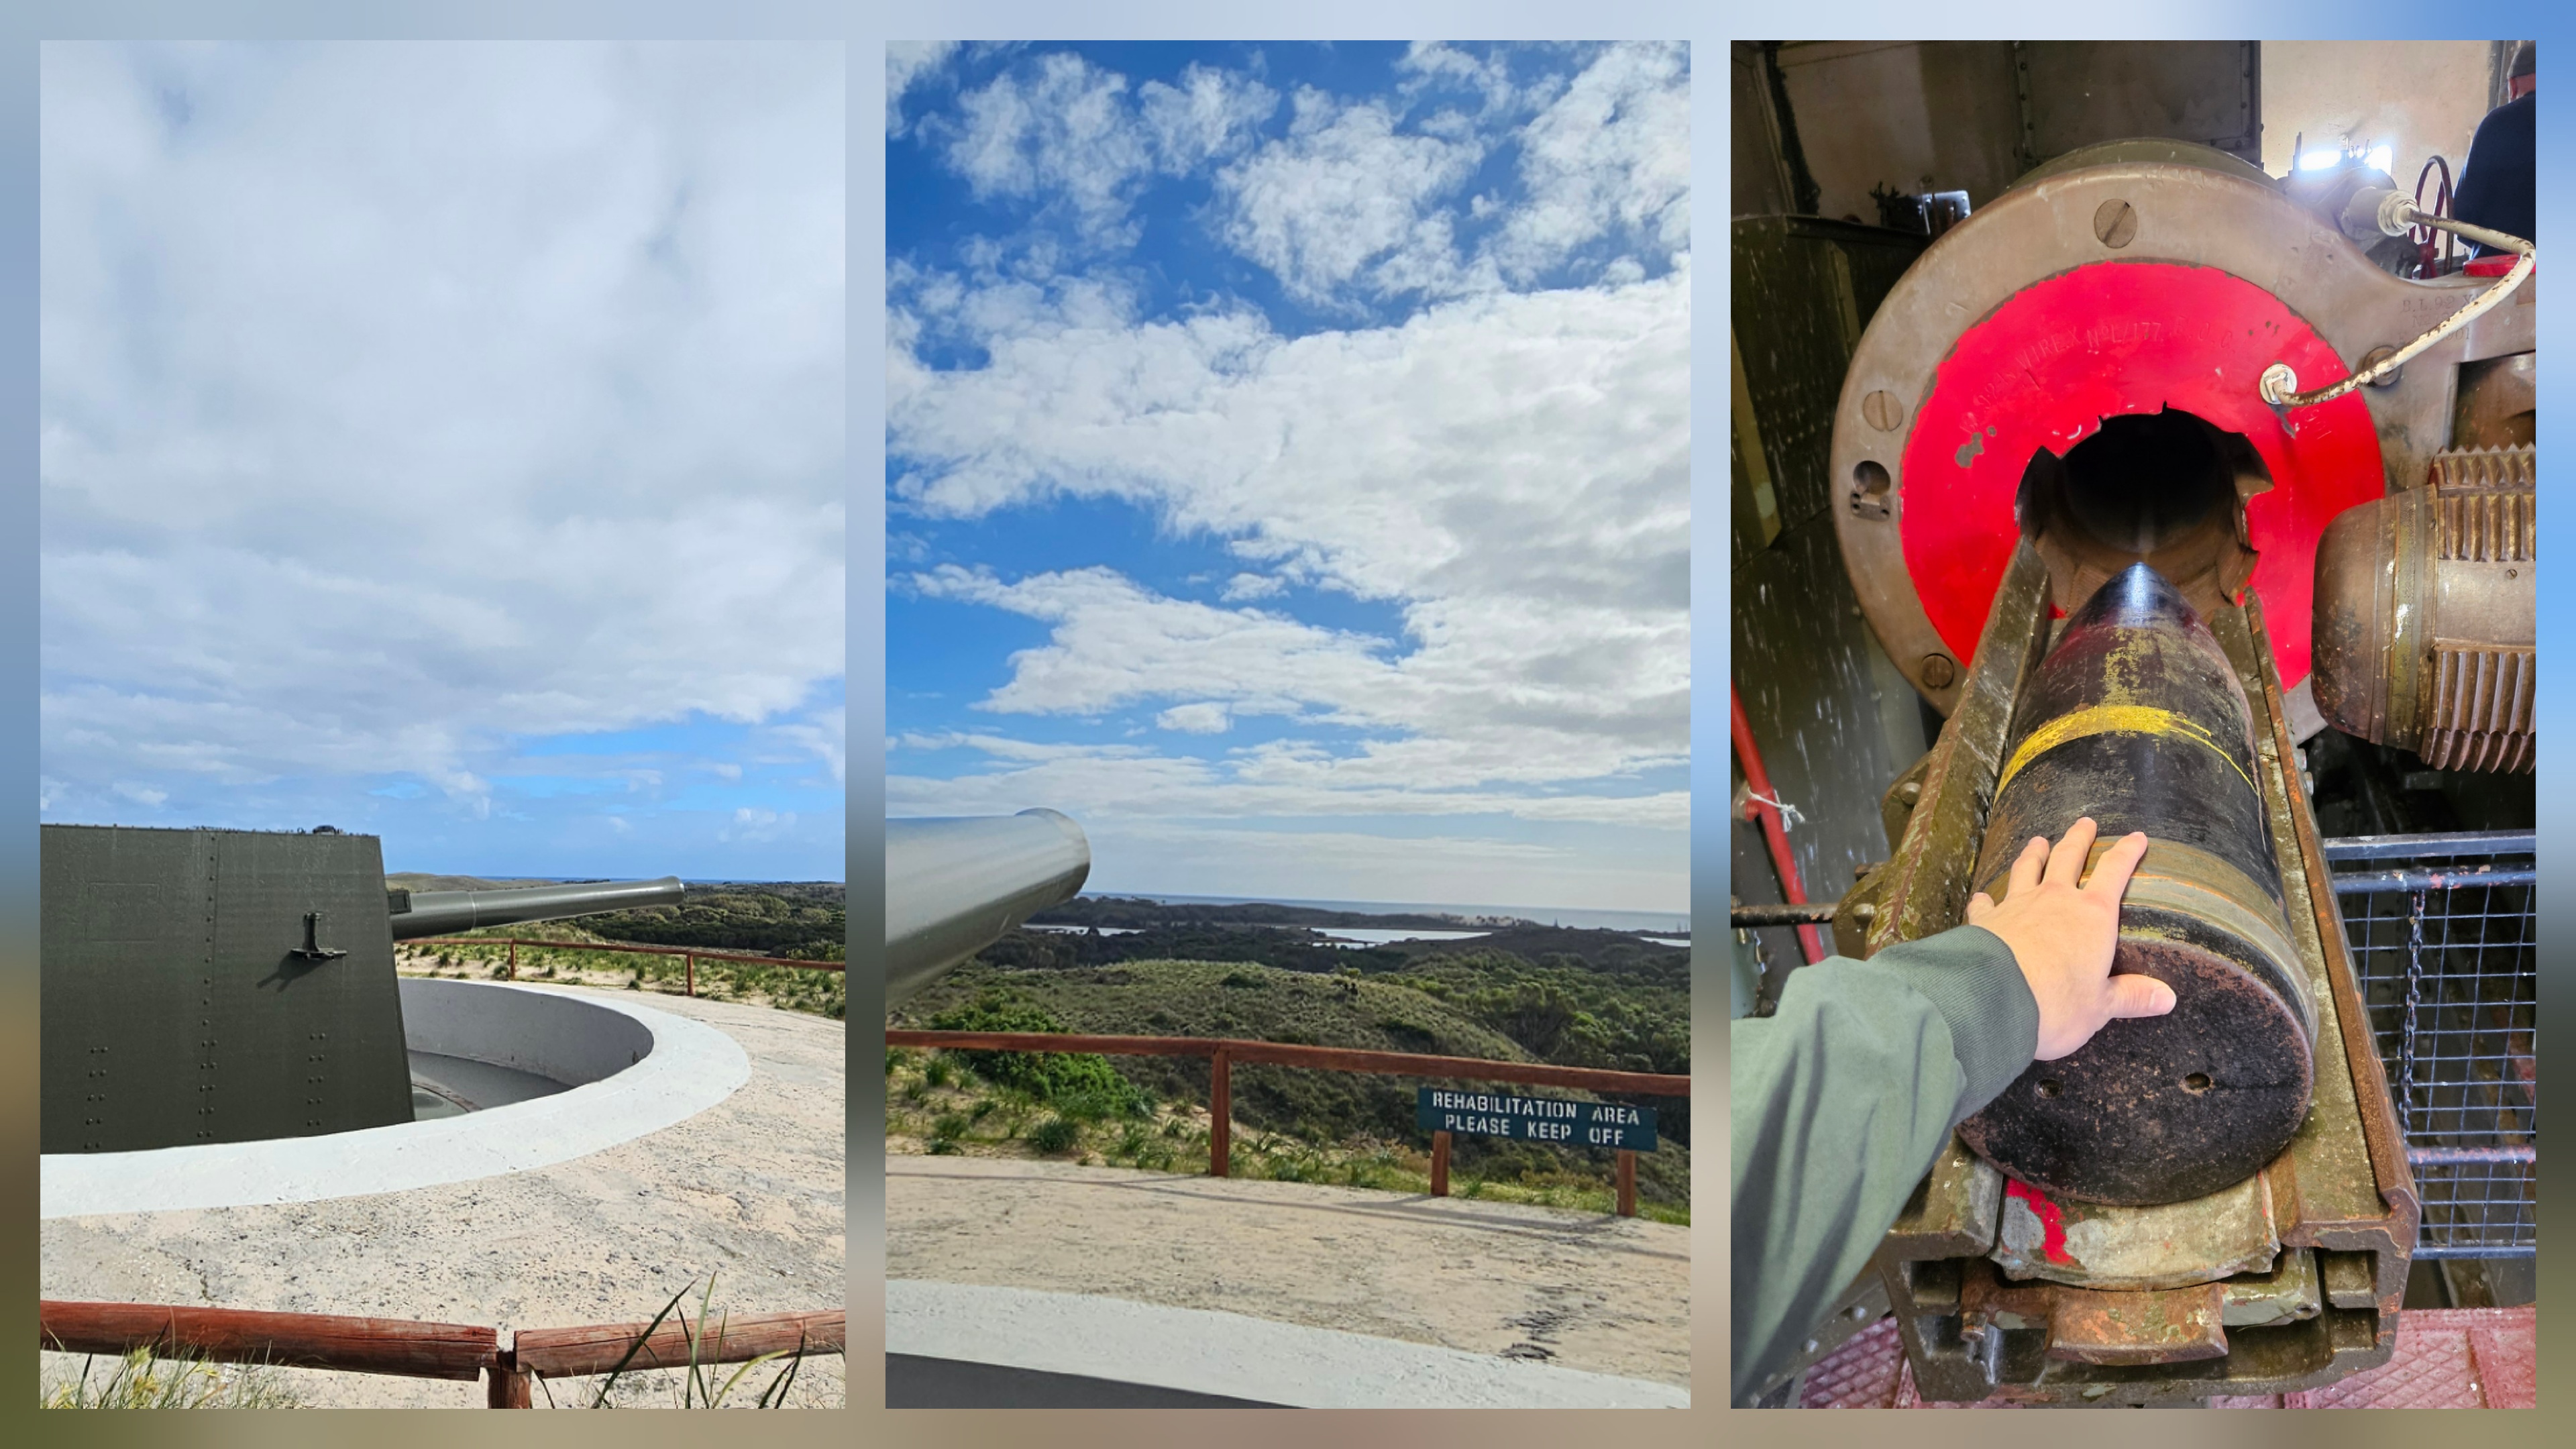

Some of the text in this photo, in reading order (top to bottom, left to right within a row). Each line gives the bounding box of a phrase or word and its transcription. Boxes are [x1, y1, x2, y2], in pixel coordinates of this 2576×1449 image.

[1433, 1091, 1640, 1126] REHABILITATION AREA
[1445, 1114, 1624, 1145] PLEASE KEEP OFF
